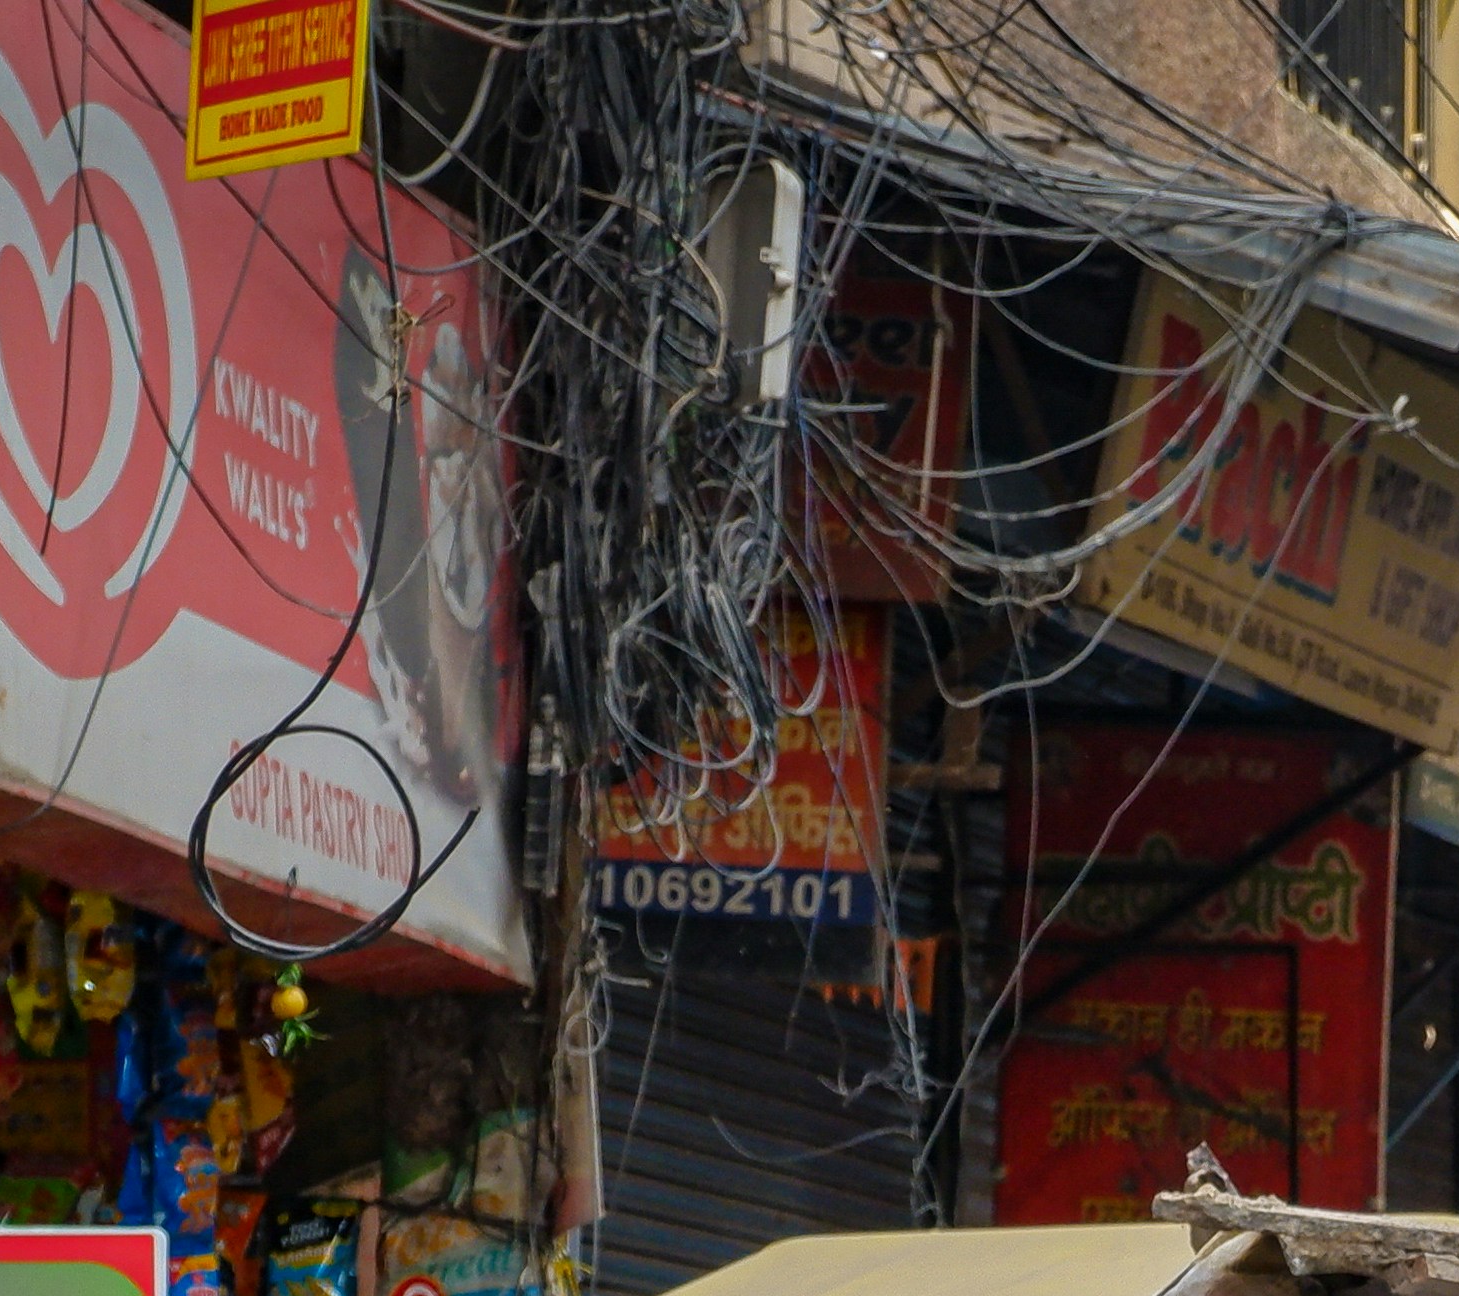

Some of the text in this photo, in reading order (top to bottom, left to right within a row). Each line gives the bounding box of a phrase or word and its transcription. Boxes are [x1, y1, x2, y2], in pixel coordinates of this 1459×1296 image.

[254, 103, 287, 134] MADE
[291, 96, 323, 127] FOOD
[213, 355, 319, 468] KWALITY
[224, 450, 308, 551] WALL'S
[229, 738, 296, 844] GUPTA
[299, 769, 367, 873] PASTRY
